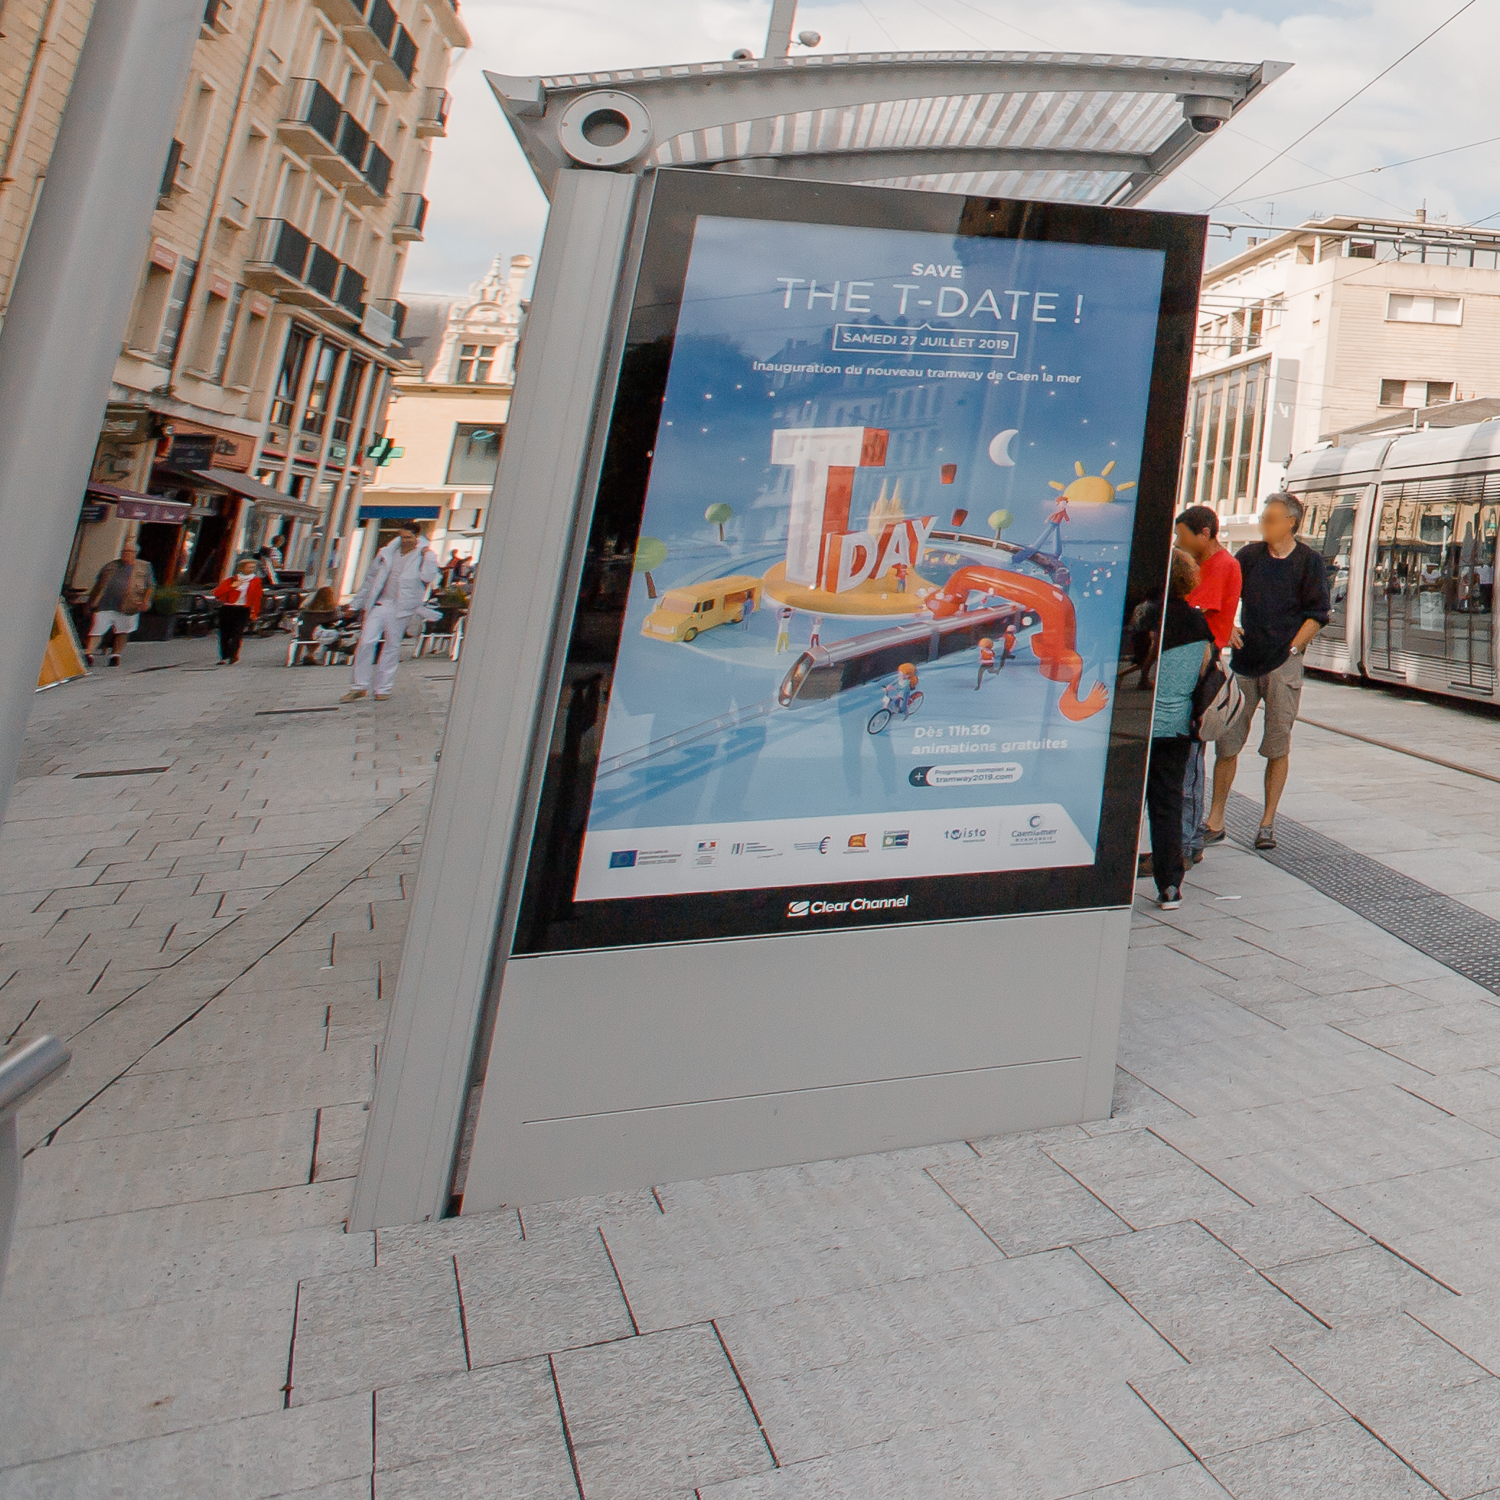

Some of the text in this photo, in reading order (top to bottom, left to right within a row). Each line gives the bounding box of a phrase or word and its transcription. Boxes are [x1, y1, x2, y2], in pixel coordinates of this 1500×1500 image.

[912, 262, 963, 279] SAVE
[777, 277, 874, 313] THE
[893, 284, 1059, 323] T-DATE
[843, 332, 1010, 350] SAMEDI 27 JUILLET 2019
[753, 361, 1082, 384] Inauguration du nouveau tramway de Caen la mer
[825, 515, 939, 595] DAY
[914, 724, 991, 739] Dès 11h30
[911, 738, 1069, 755] animations gratuites
[934, 768, 975, 776] Programme
[935, 773, 1014, 783] tramway2019.com
[944, 827, 987, 840] twisto
[810, 894, 909, 914] Clear Channel
